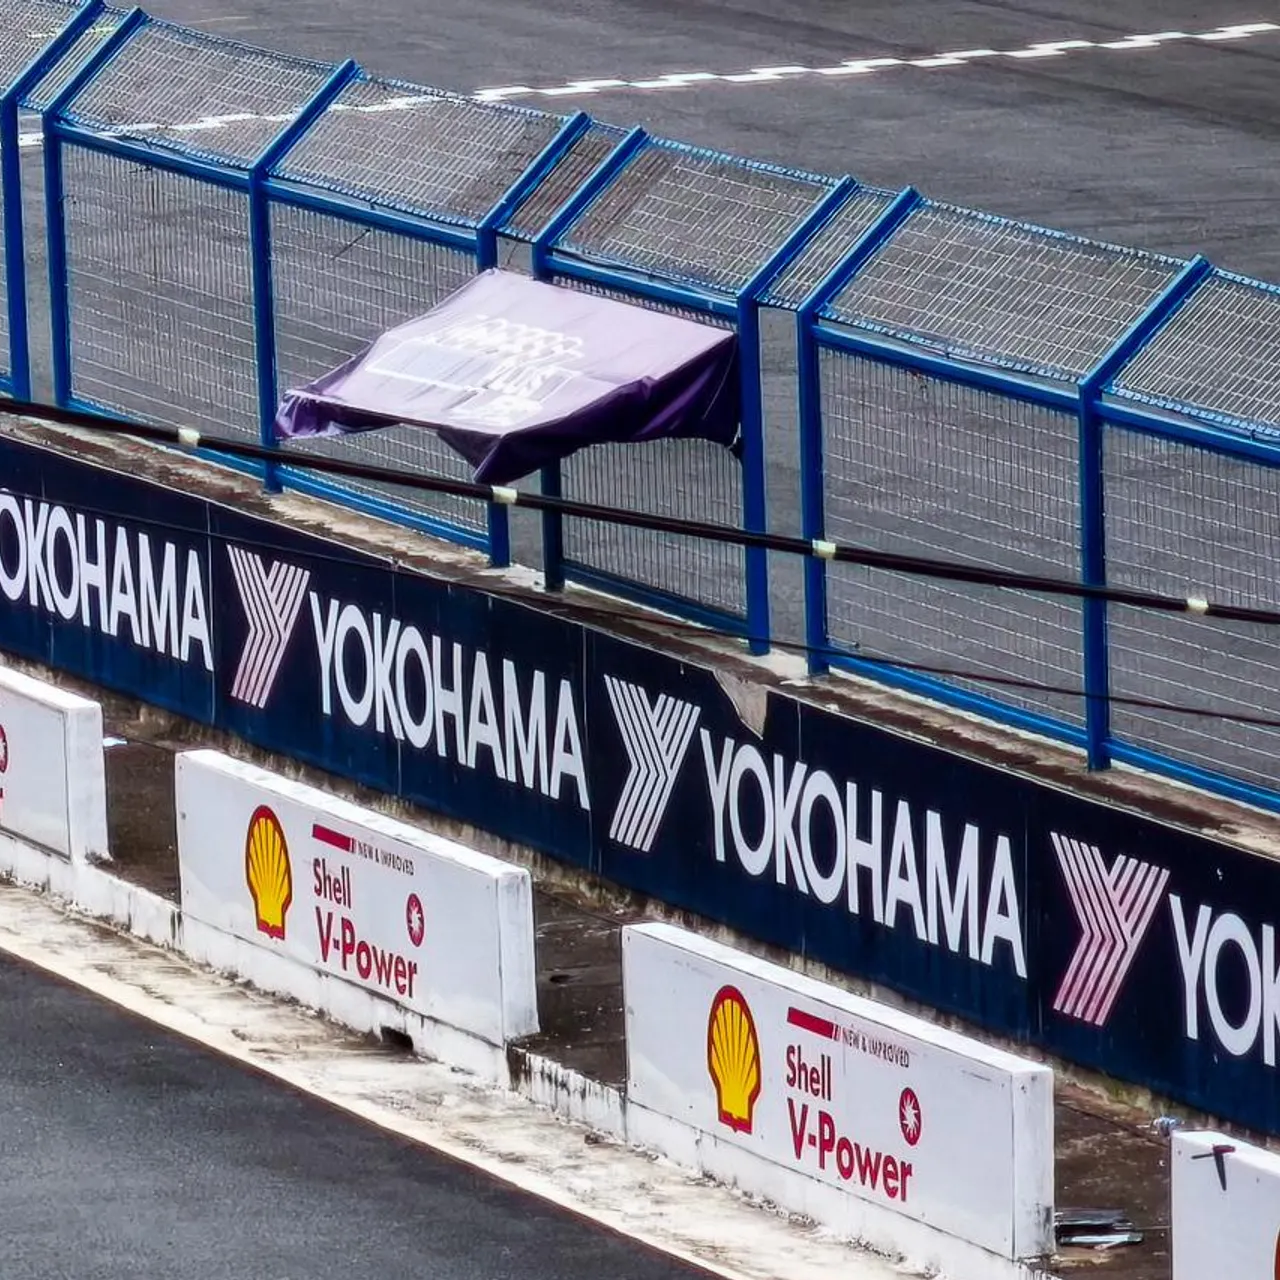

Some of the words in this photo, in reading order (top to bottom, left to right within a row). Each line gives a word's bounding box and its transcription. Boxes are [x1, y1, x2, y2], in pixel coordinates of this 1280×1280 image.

[311, 590, 590, 811] YOKOHAMA
[313, 857, 352, 910] Shell
[358, 840, 374, 860] NEW
[381, 851, 414, 876] IMPROVED
[700, 728, 1027, 979] YOKOHAMA
[315, 905, 418, 999] V-Power
[786, 1044, 832, 1101] Shell
[843, 1028, 861, 1049] NEW
[868, 1038, 910, 1068] IMPROVED
[787, 1097, 913, 1202] V-Power
